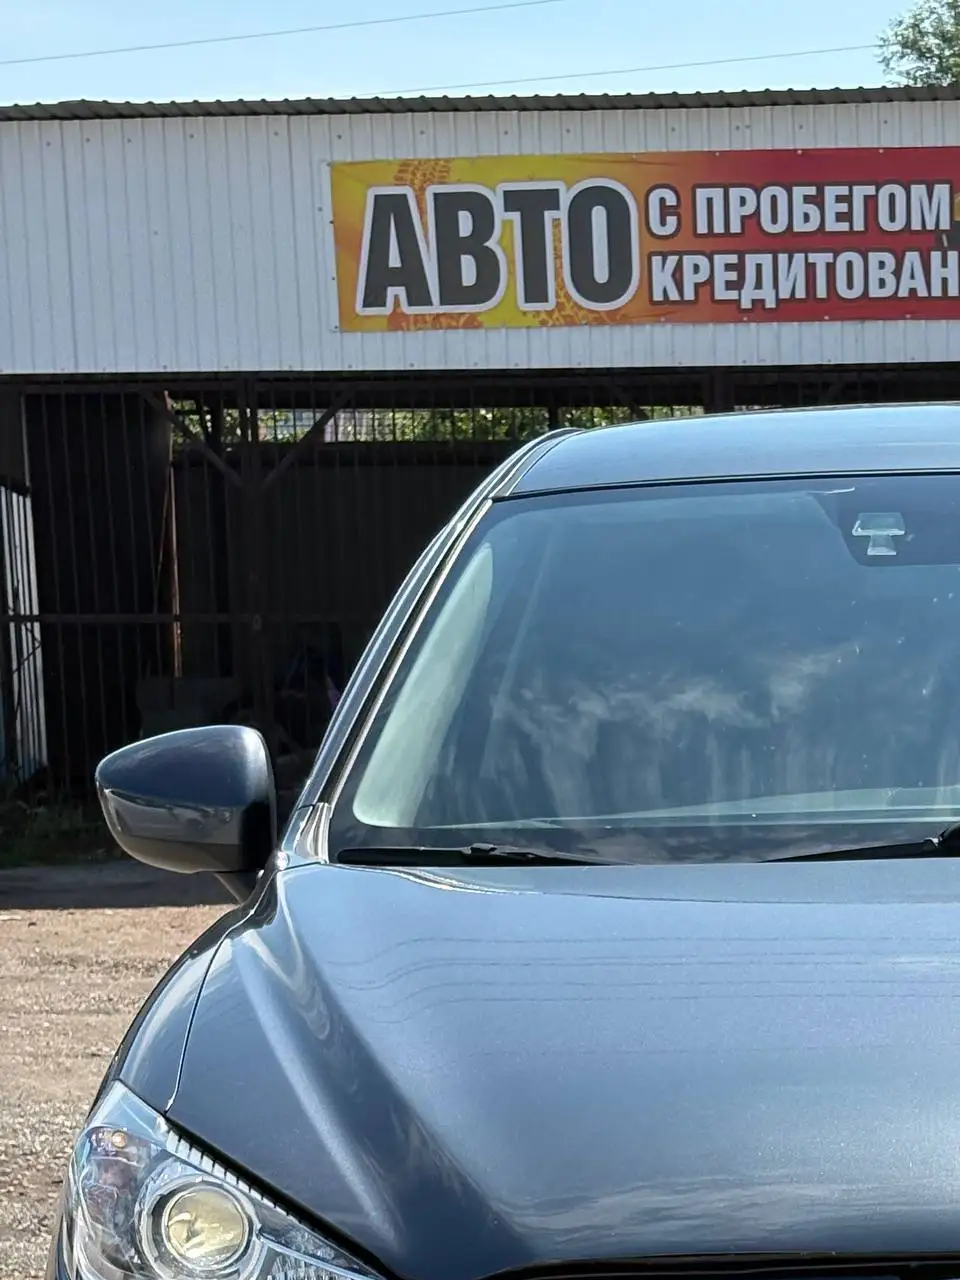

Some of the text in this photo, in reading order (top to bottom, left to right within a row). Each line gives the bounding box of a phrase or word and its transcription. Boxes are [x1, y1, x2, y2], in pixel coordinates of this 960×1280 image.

[357, 178, 640, 315] АВТО
[648, 183, 952, 236] С ПРОБЕГОМ
